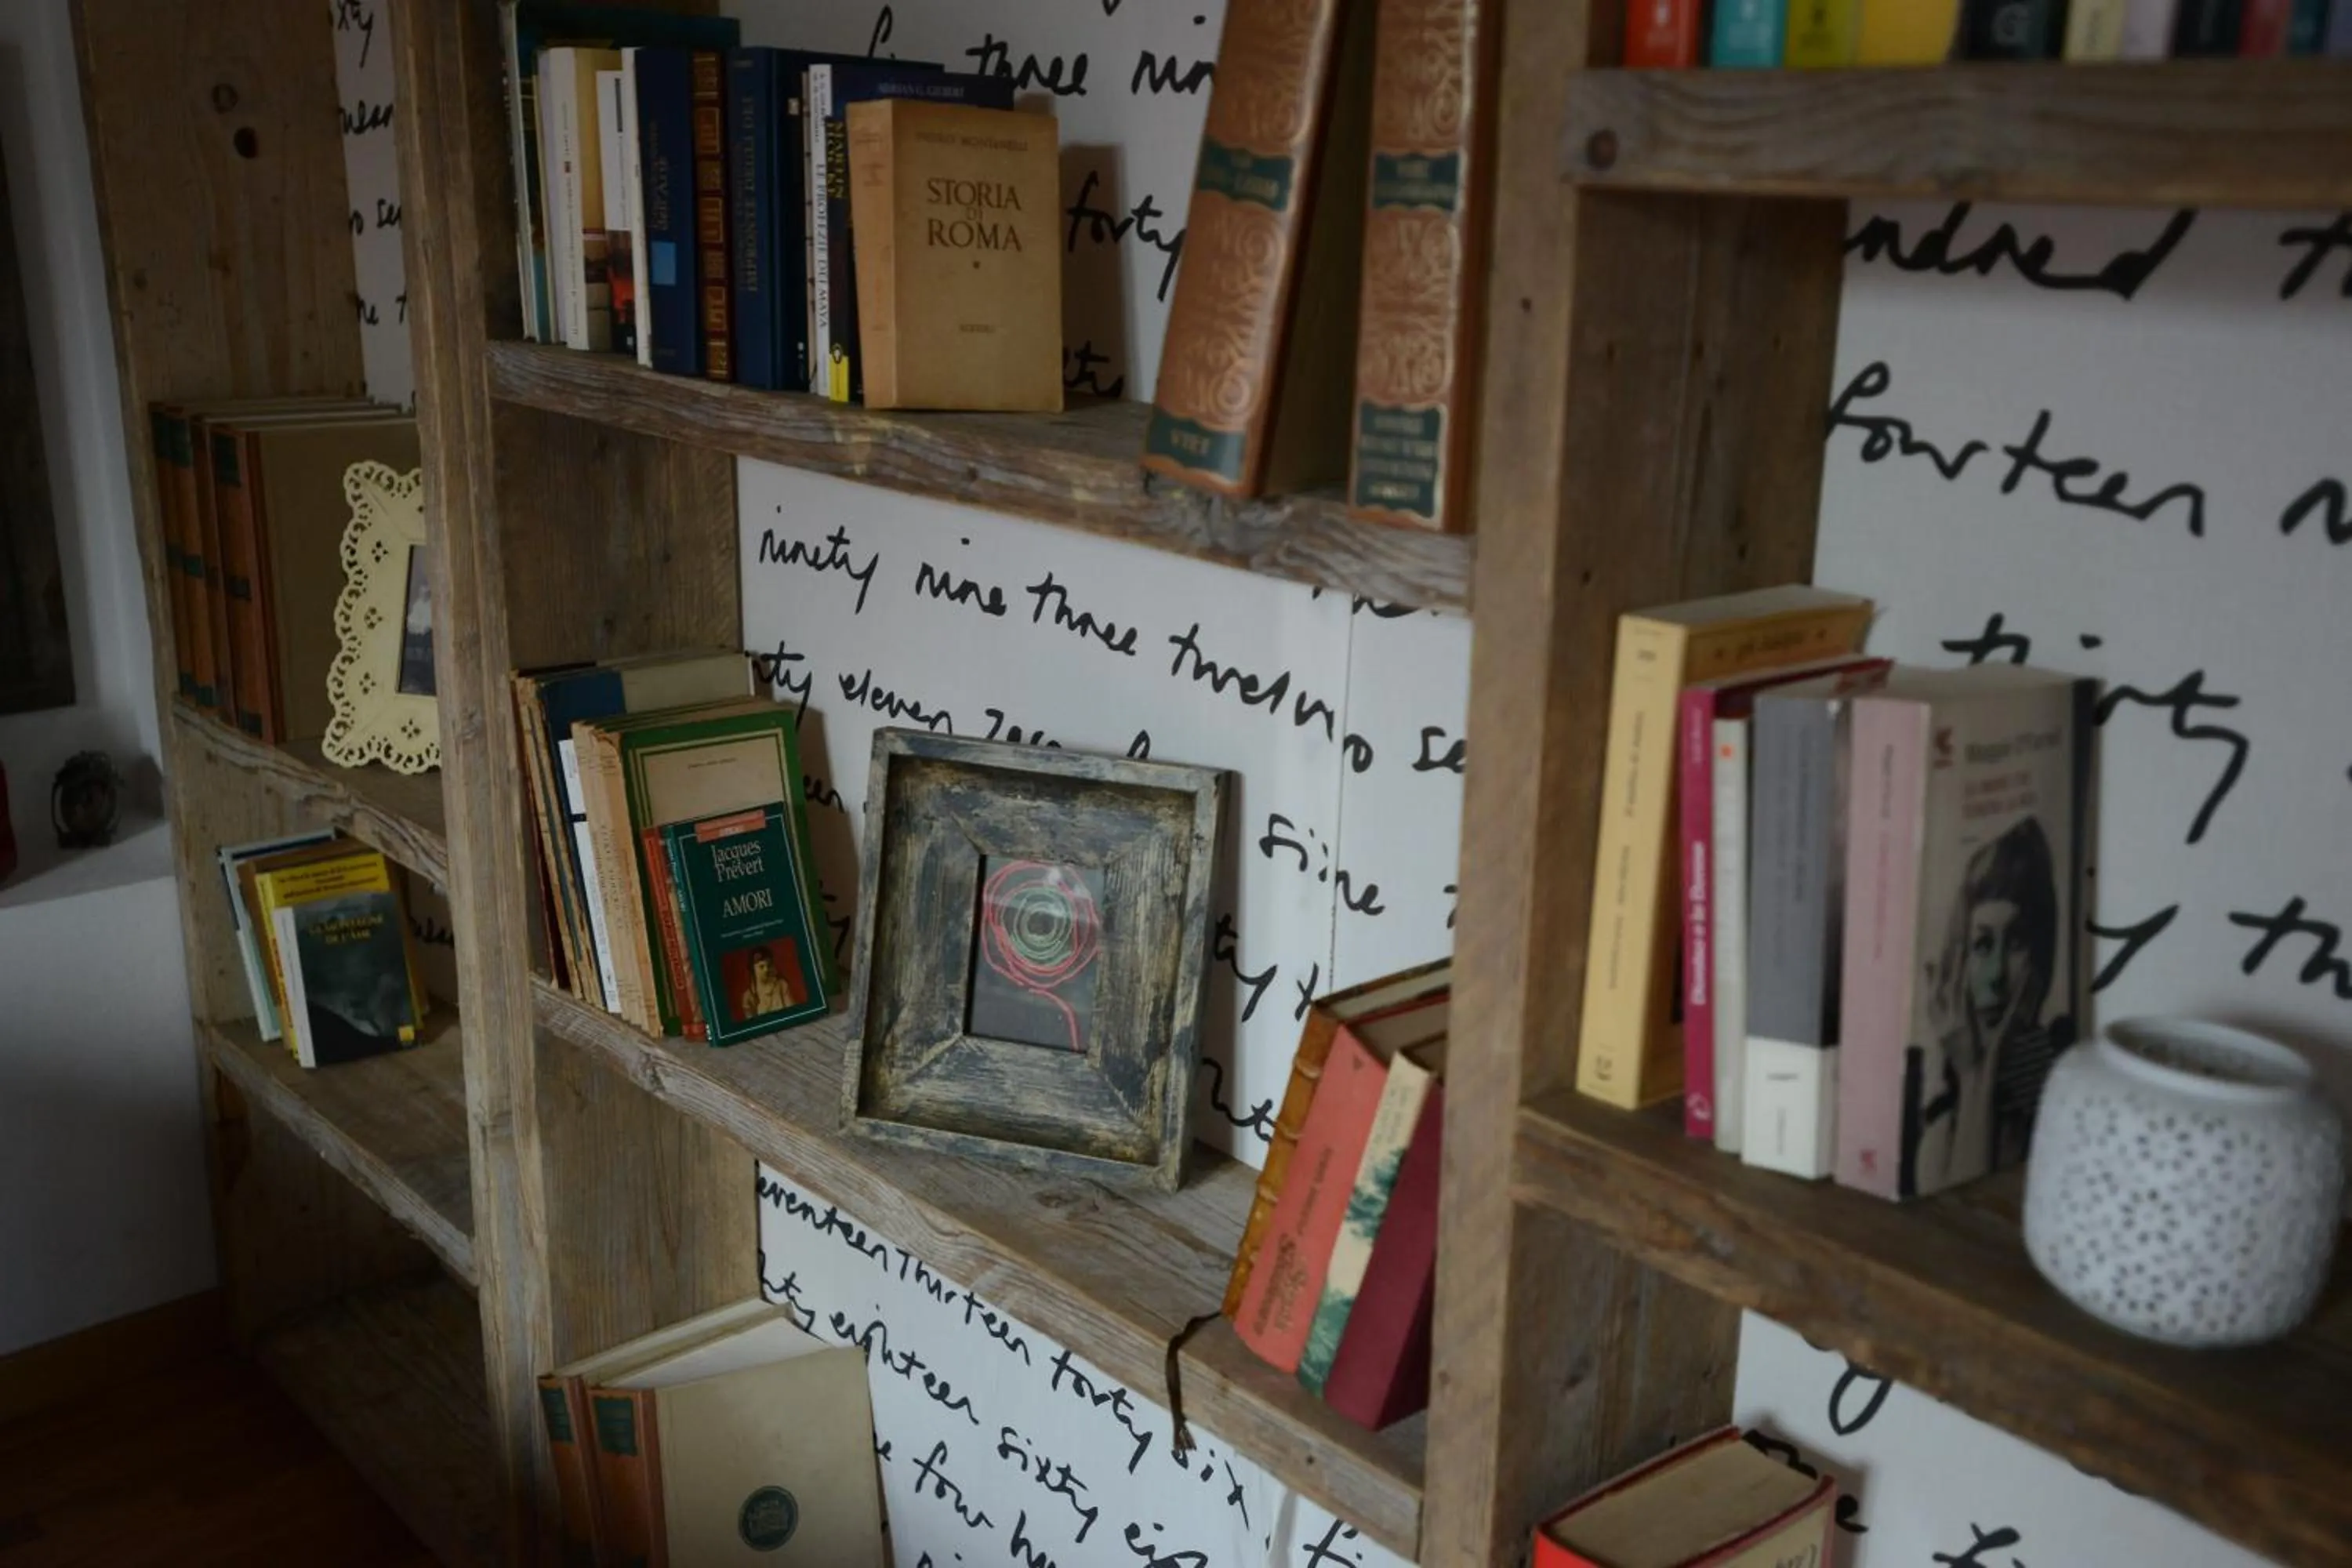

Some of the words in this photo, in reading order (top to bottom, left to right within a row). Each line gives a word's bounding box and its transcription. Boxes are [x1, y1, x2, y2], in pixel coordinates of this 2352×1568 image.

[926, 177, 1022, 212] STORIA
[966, 207, 984, 223] DI
[927, 217, 1023, 253] ROMA
[759, 504, 880, 615] ninety
[915, 536, 1007, 617] nine
[1026, 572, 1138, 657] three
[710, 838, 763, 866] Jacques
[714, 856, 765, 884] Prévert
[721, 887, 774, 919] AMORI
[996, 1425, 1099, 1544] sixty
